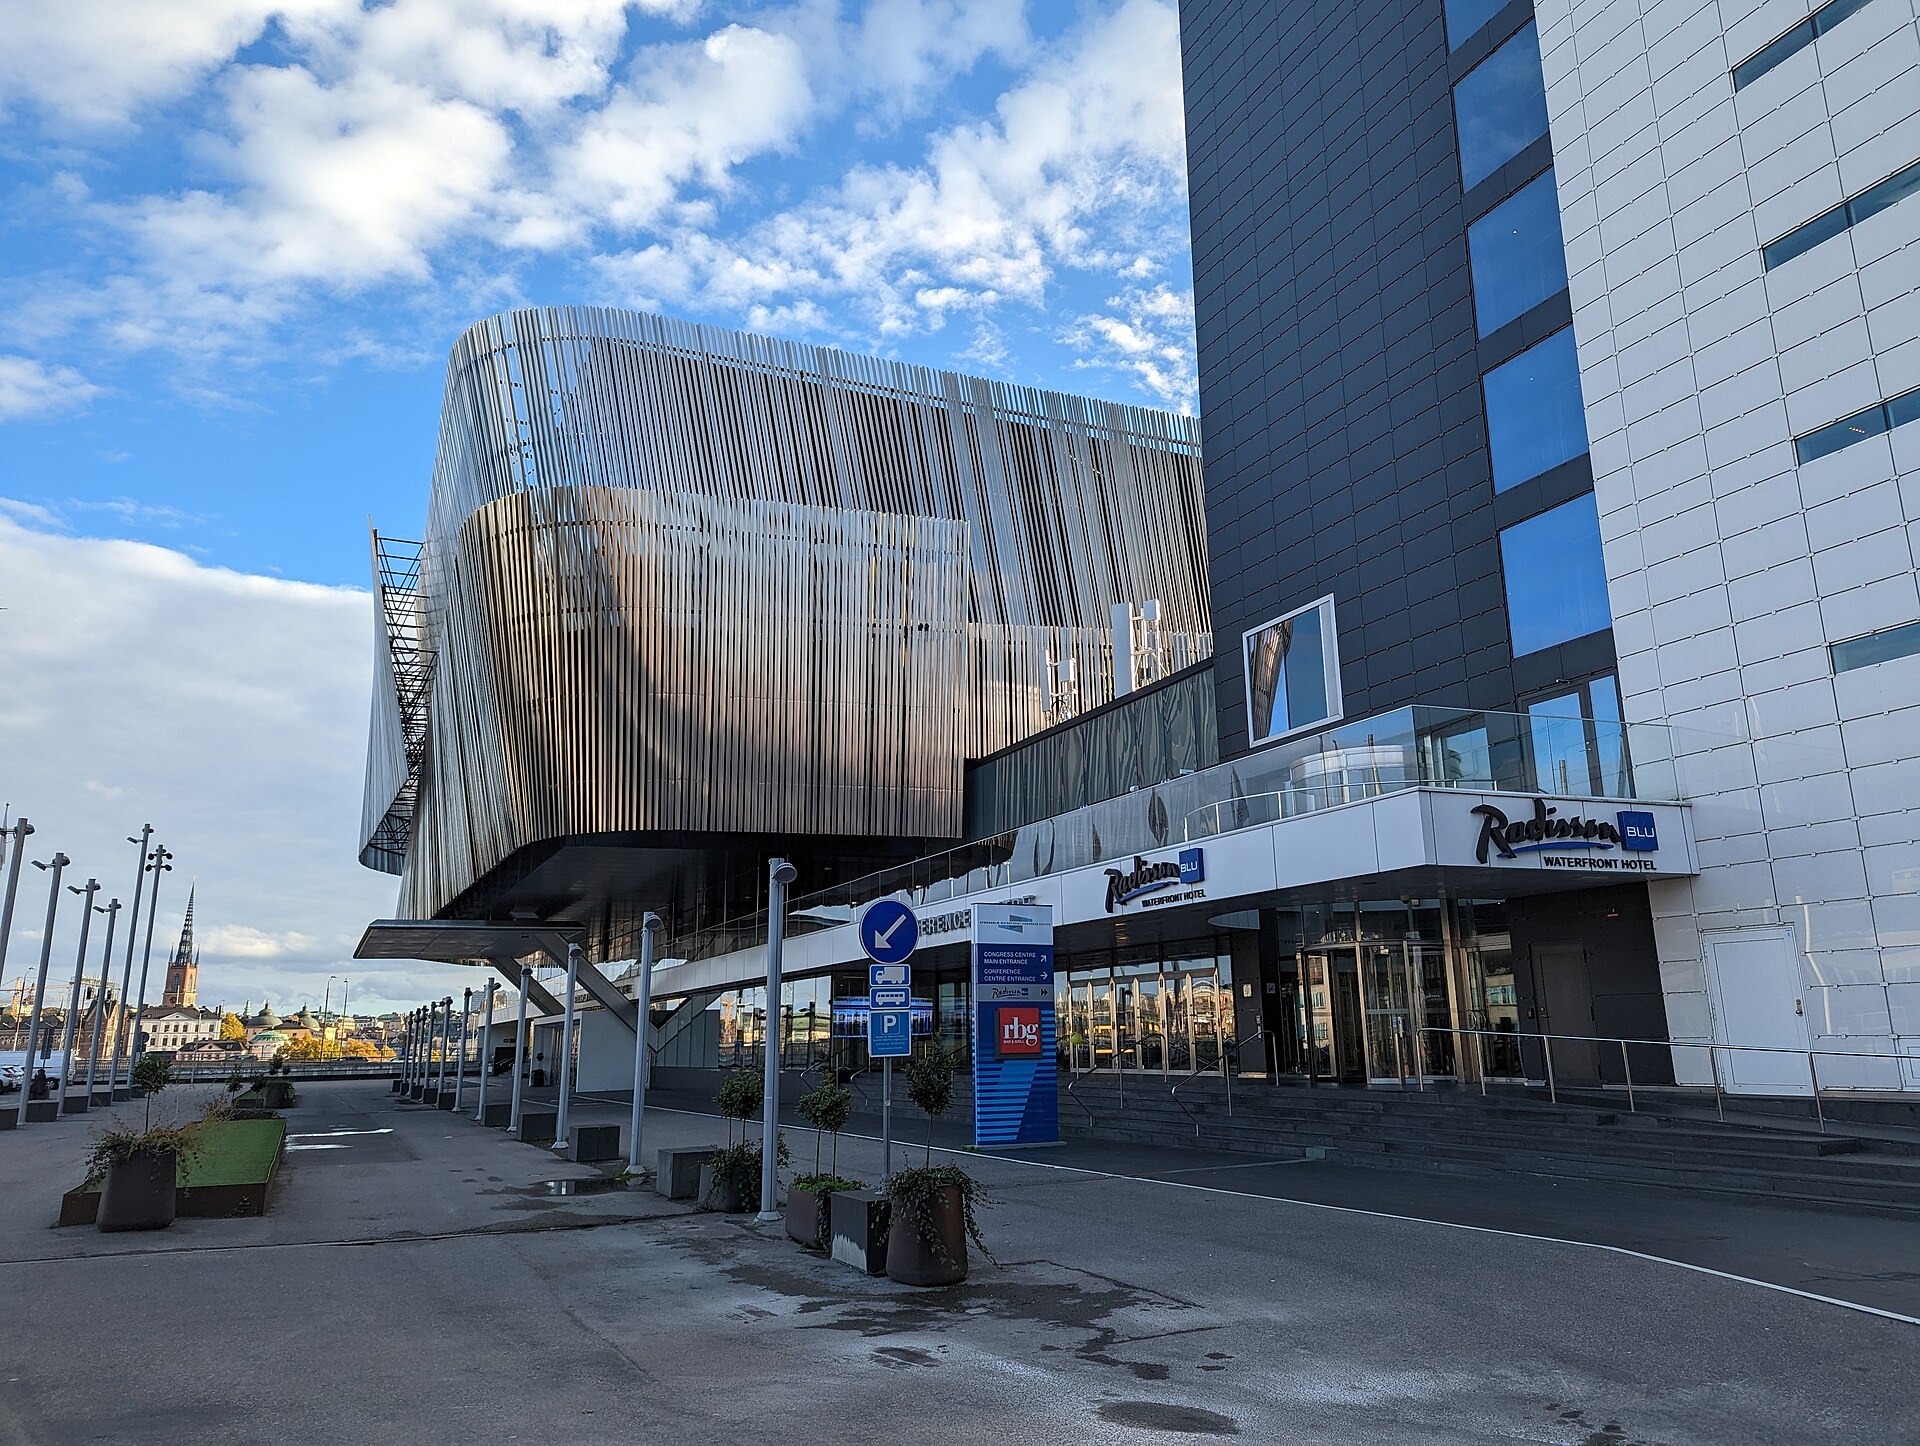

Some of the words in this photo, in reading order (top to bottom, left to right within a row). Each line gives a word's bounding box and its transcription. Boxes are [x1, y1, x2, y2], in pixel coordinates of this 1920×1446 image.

[1470, 798, 1622, 864] Radisson
[1626, 826, 1655, 838] BLU
[1543, 856, 1619, 869] WATERFRONT
[1621, 860, 1657, 870] HOTEL
[1104, 856, 1180, 913] Radisson
[1181, 861, 1198, 873] BLU
[1141, 893, 1183, 907] WATERFRONT
[1184, 889, 1206, 900] HOTEL
[884, 1015, 896, 1033] P
[1003, 1016, 1038, 1046] rbg
